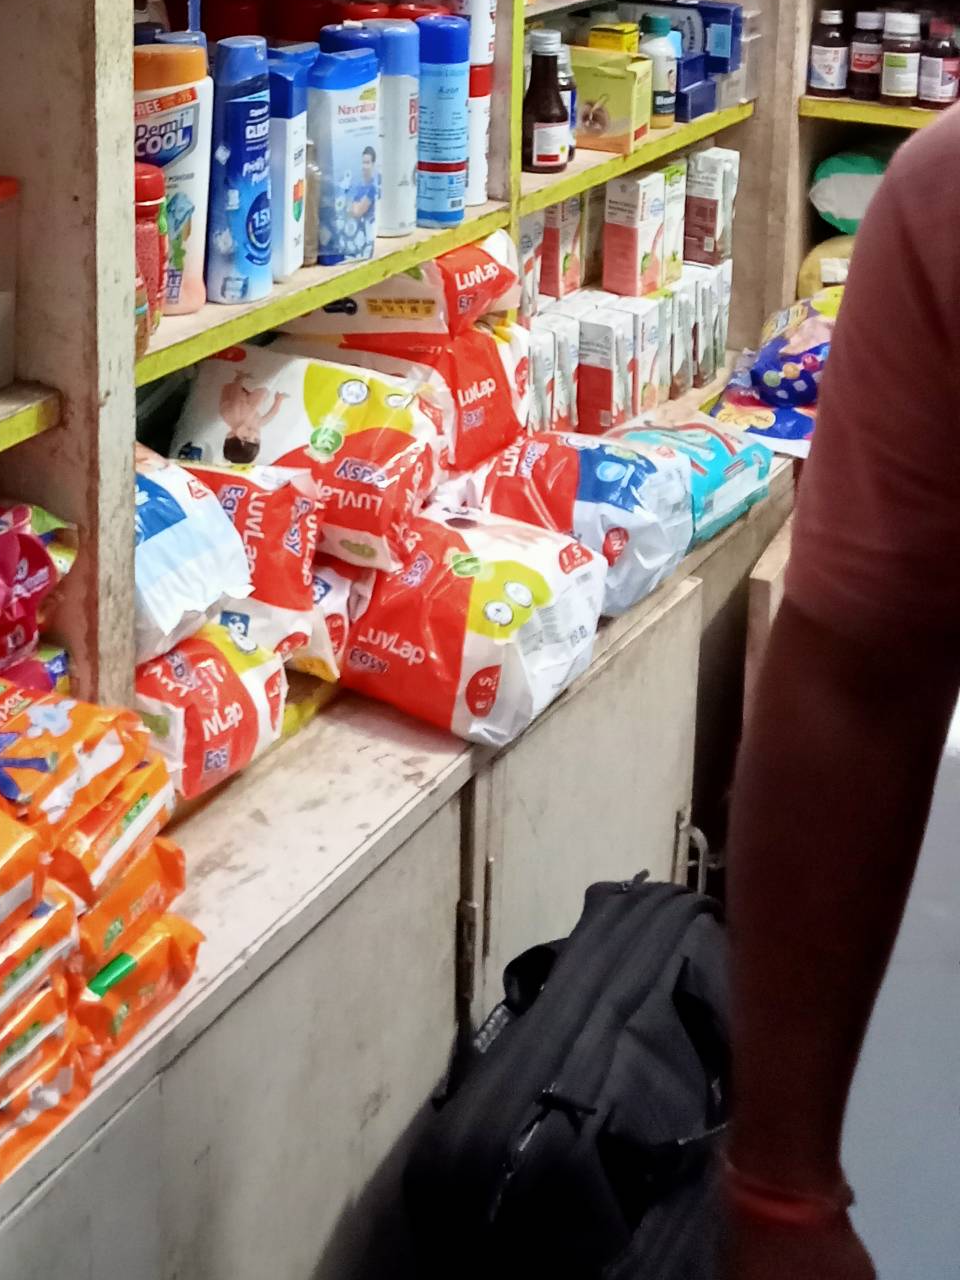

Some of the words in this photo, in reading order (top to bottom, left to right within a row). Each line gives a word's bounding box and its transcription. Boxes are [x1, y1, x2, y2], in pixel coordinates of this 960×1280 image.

[134, 128, 190, 157] COOL
[455, 262, 500, 291] LuvLap
[457, 377, 497, 408] LuvLap
